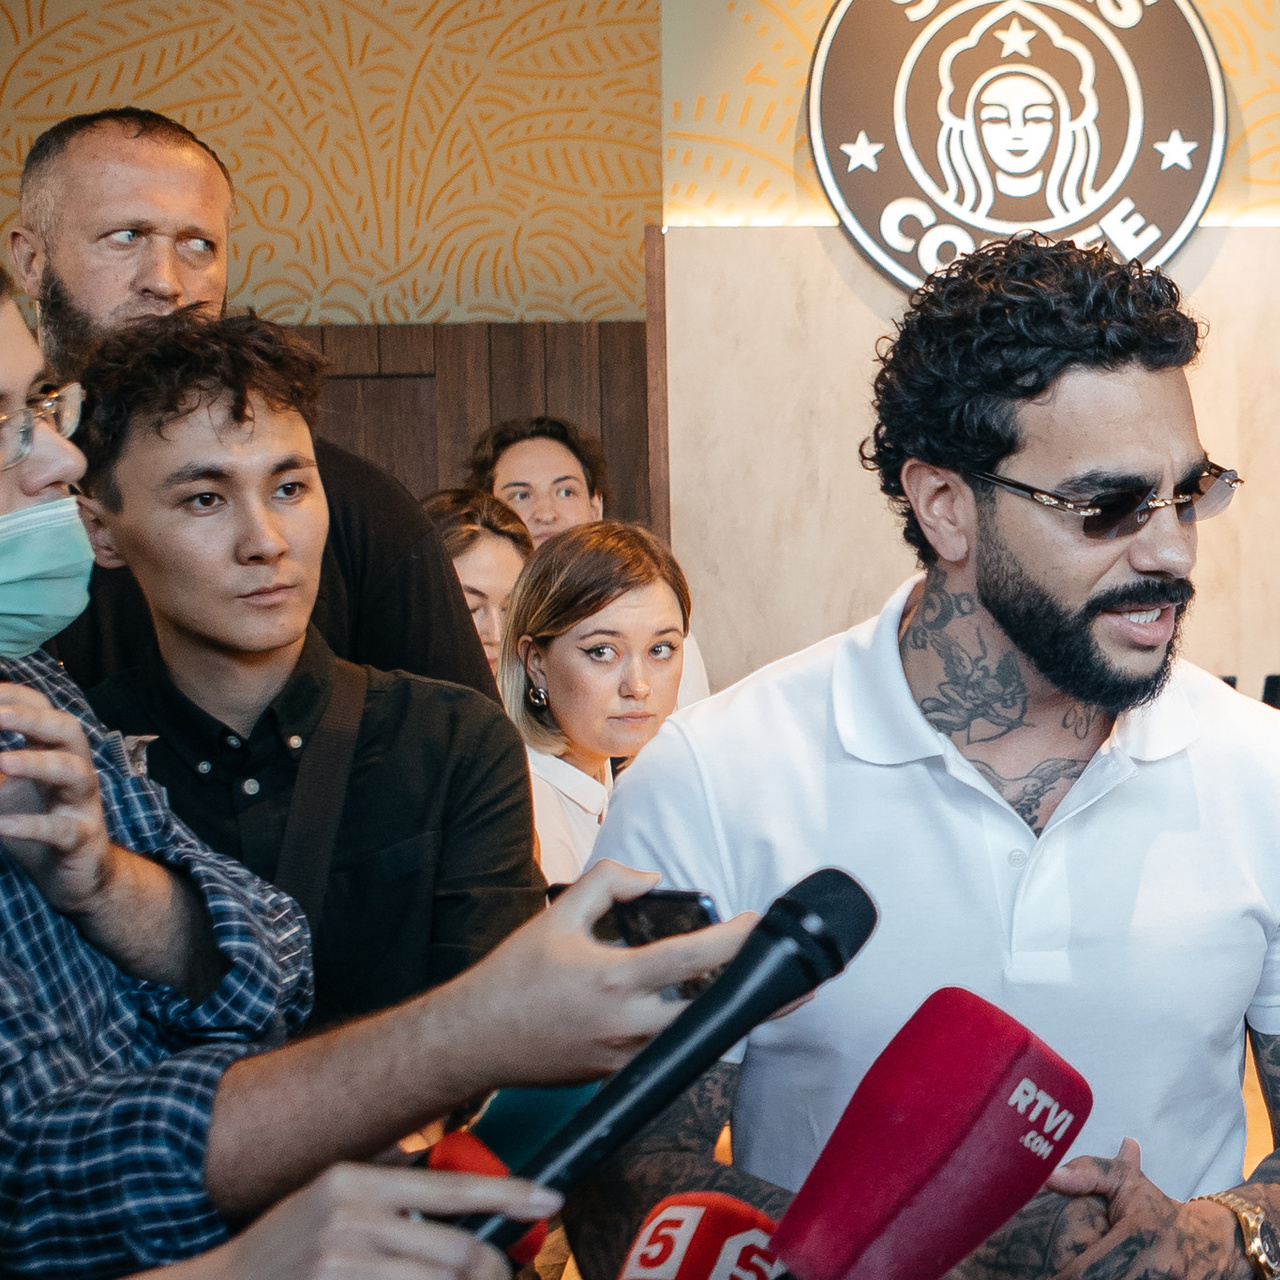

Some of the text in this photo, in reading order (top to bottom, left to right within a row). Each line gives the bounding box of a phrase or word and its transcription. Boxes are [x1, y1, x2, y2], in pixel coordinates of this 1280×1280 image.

[879, 197, 1162, 275] COE
[1007, 1077, 1074, 1141] RTVI
[639, 1219, 685, 1269] 5
